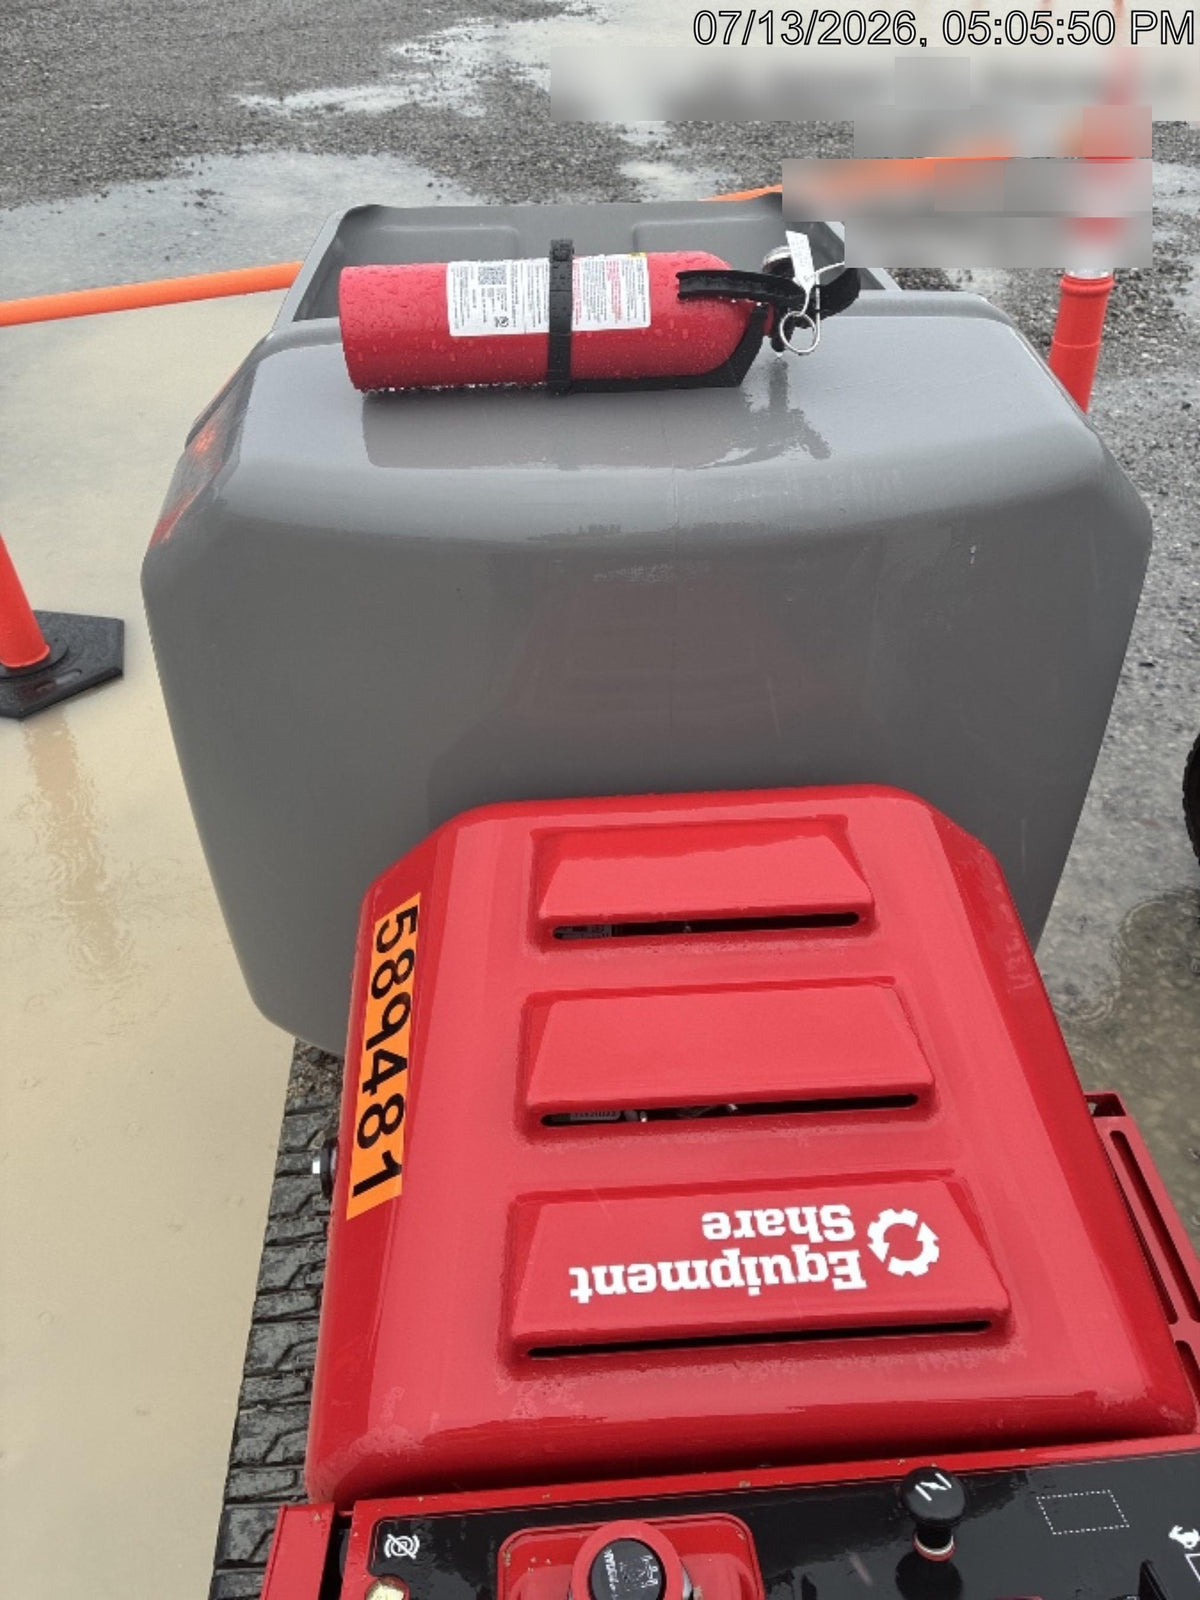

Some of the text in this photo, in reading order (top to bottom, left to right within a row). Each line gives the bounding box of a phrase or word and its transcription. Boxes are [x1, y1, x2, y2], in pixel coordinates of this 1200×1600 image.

[353, 905, 418, 1197] 589481
[701, 1204, 856, 1244] Share
[568, 1243, 867, 1304] Equipment
